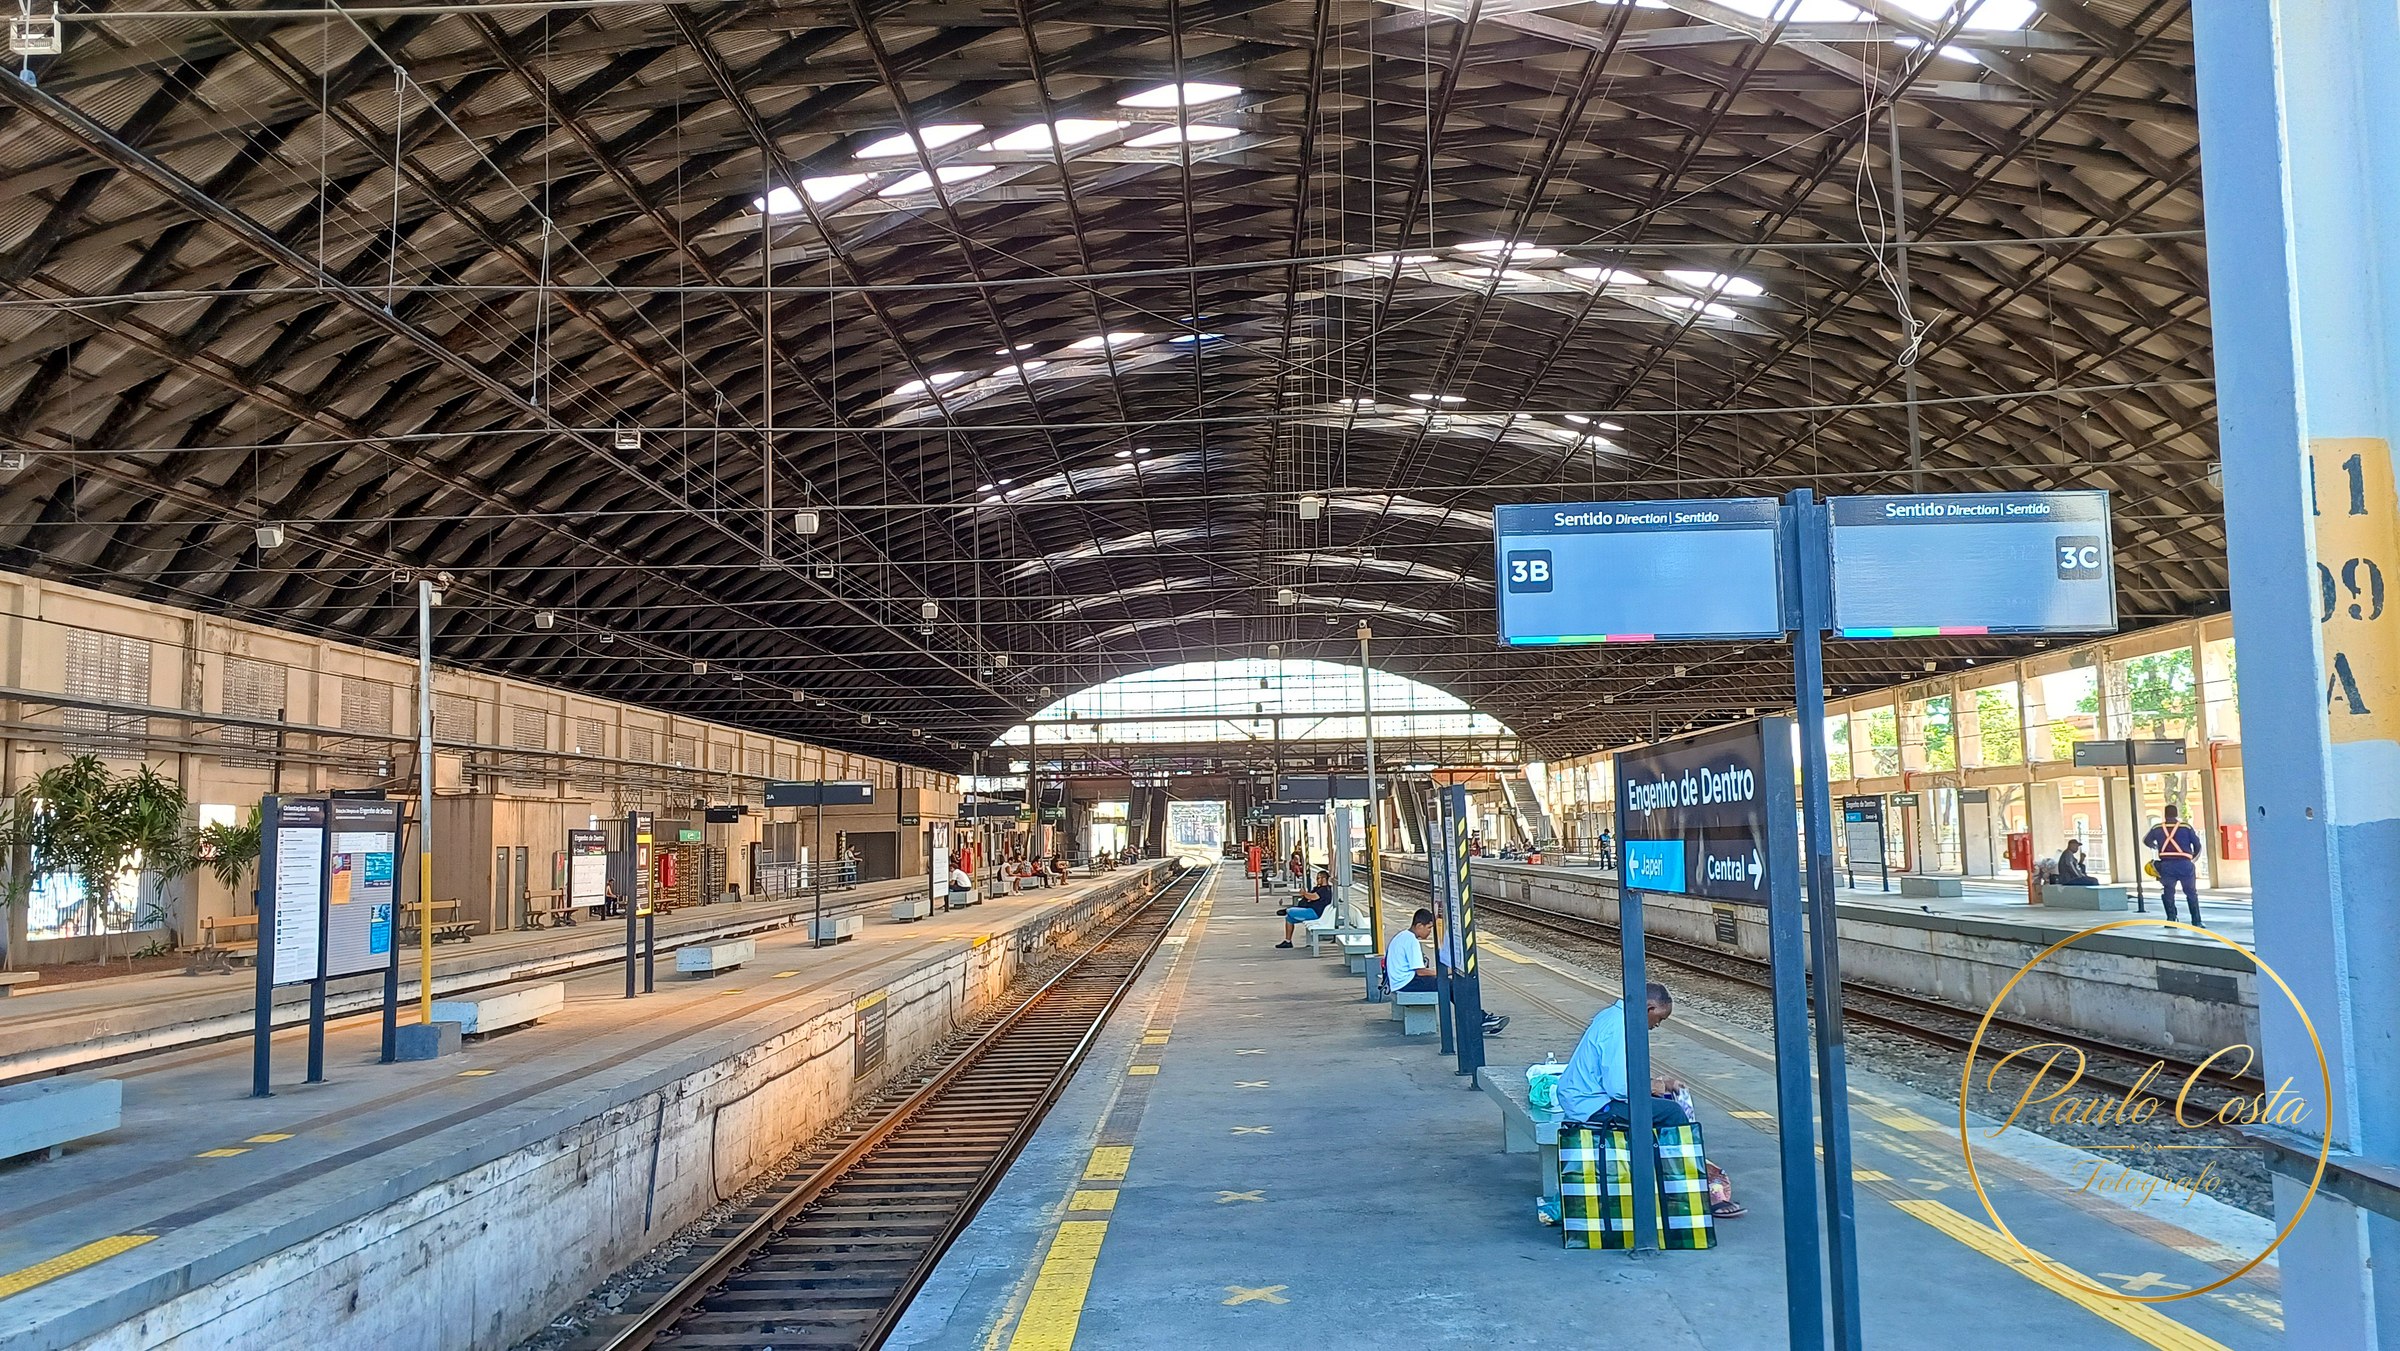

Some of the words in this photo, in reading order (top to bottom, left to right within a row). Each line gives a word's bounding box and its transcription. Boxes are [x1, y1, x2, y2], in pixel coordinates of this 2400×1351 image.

[1554, 511, 1613, 527] Sentido
[1615, 513, 1668, 525] Direction
[1674, 512, 1720, 524] Sentido
[1885, 502, 1945, 517] Sentido
[1947, 504, 2000, 516] Direction
[2005, 503, 2051, 515] Sentido
[2060, 546, 2100, 569] 3C
[1511, 560, 1550, 583] 3B
[2327, 652, 2371, 715] A
[1627, 773, 1678, 817] Engenho
[1680, 769, 1699, 807] de
[1700, 764, 1755, 805] Dentro
[1640, 853, 1663, 880] Japeri
[1707, 854, 1746, 882] Central
